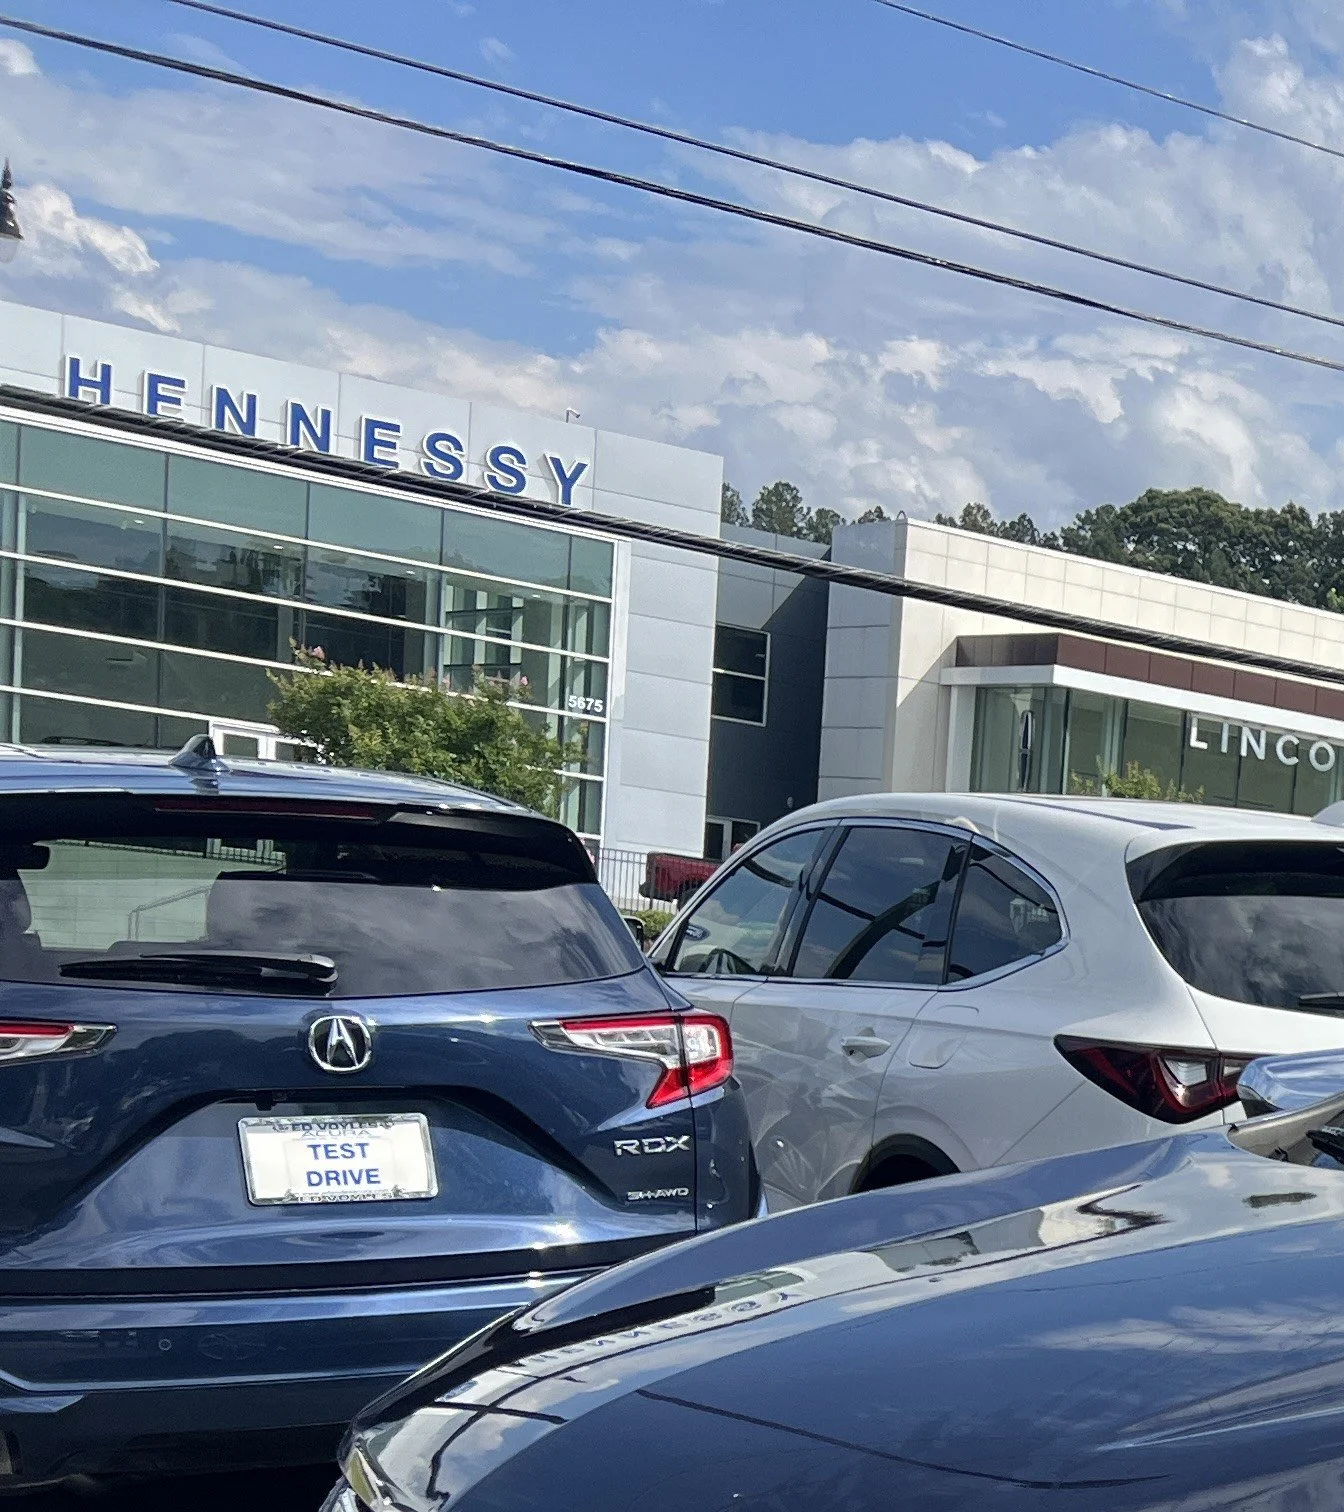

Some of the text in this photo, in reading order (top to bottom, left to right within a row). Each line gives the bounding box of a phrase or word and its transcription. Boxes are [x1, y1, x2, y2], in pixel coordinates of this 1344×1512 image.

[64, 355, 589, 507] HENNESSY
[568, 695, 603, 713] 5675
[306, 1142, 370, 1161] TEST
[613, 1135, 690, 1156] RDX
[305, 1168, 382, 1188] DRIVE
